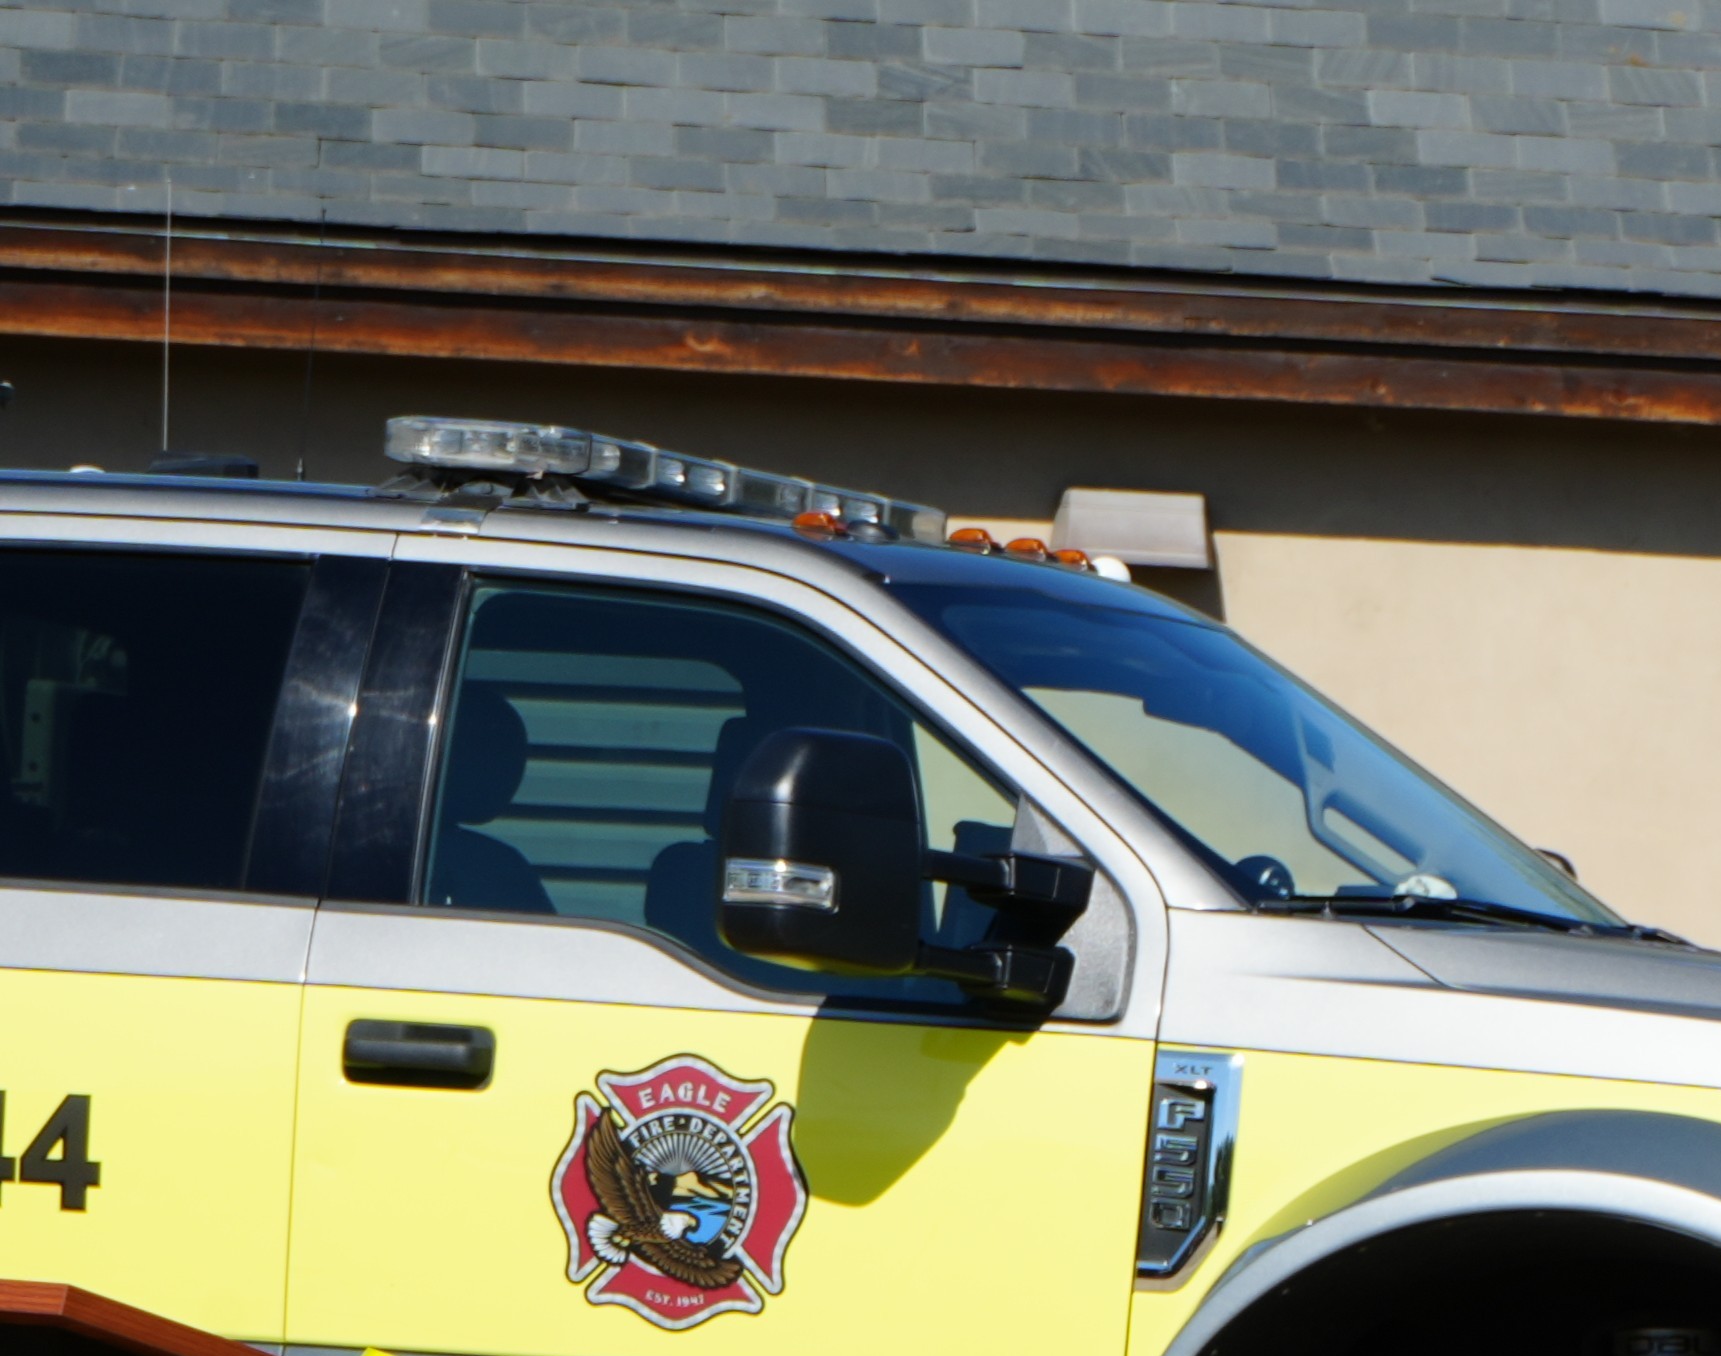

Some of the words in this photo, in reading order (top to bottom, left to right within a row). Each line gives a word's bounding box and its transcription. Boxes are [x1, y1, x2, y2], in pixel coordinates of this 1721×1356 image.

[638, 1081, 732, 1113] EAGLE
[1174, 1064, 1213, 1076] XLT
[0, 1089, 101, 1214] 4
[630, 1115, 675, 1149] FIRE
[688, 1115, 753, 1250] DEPARTMENT
